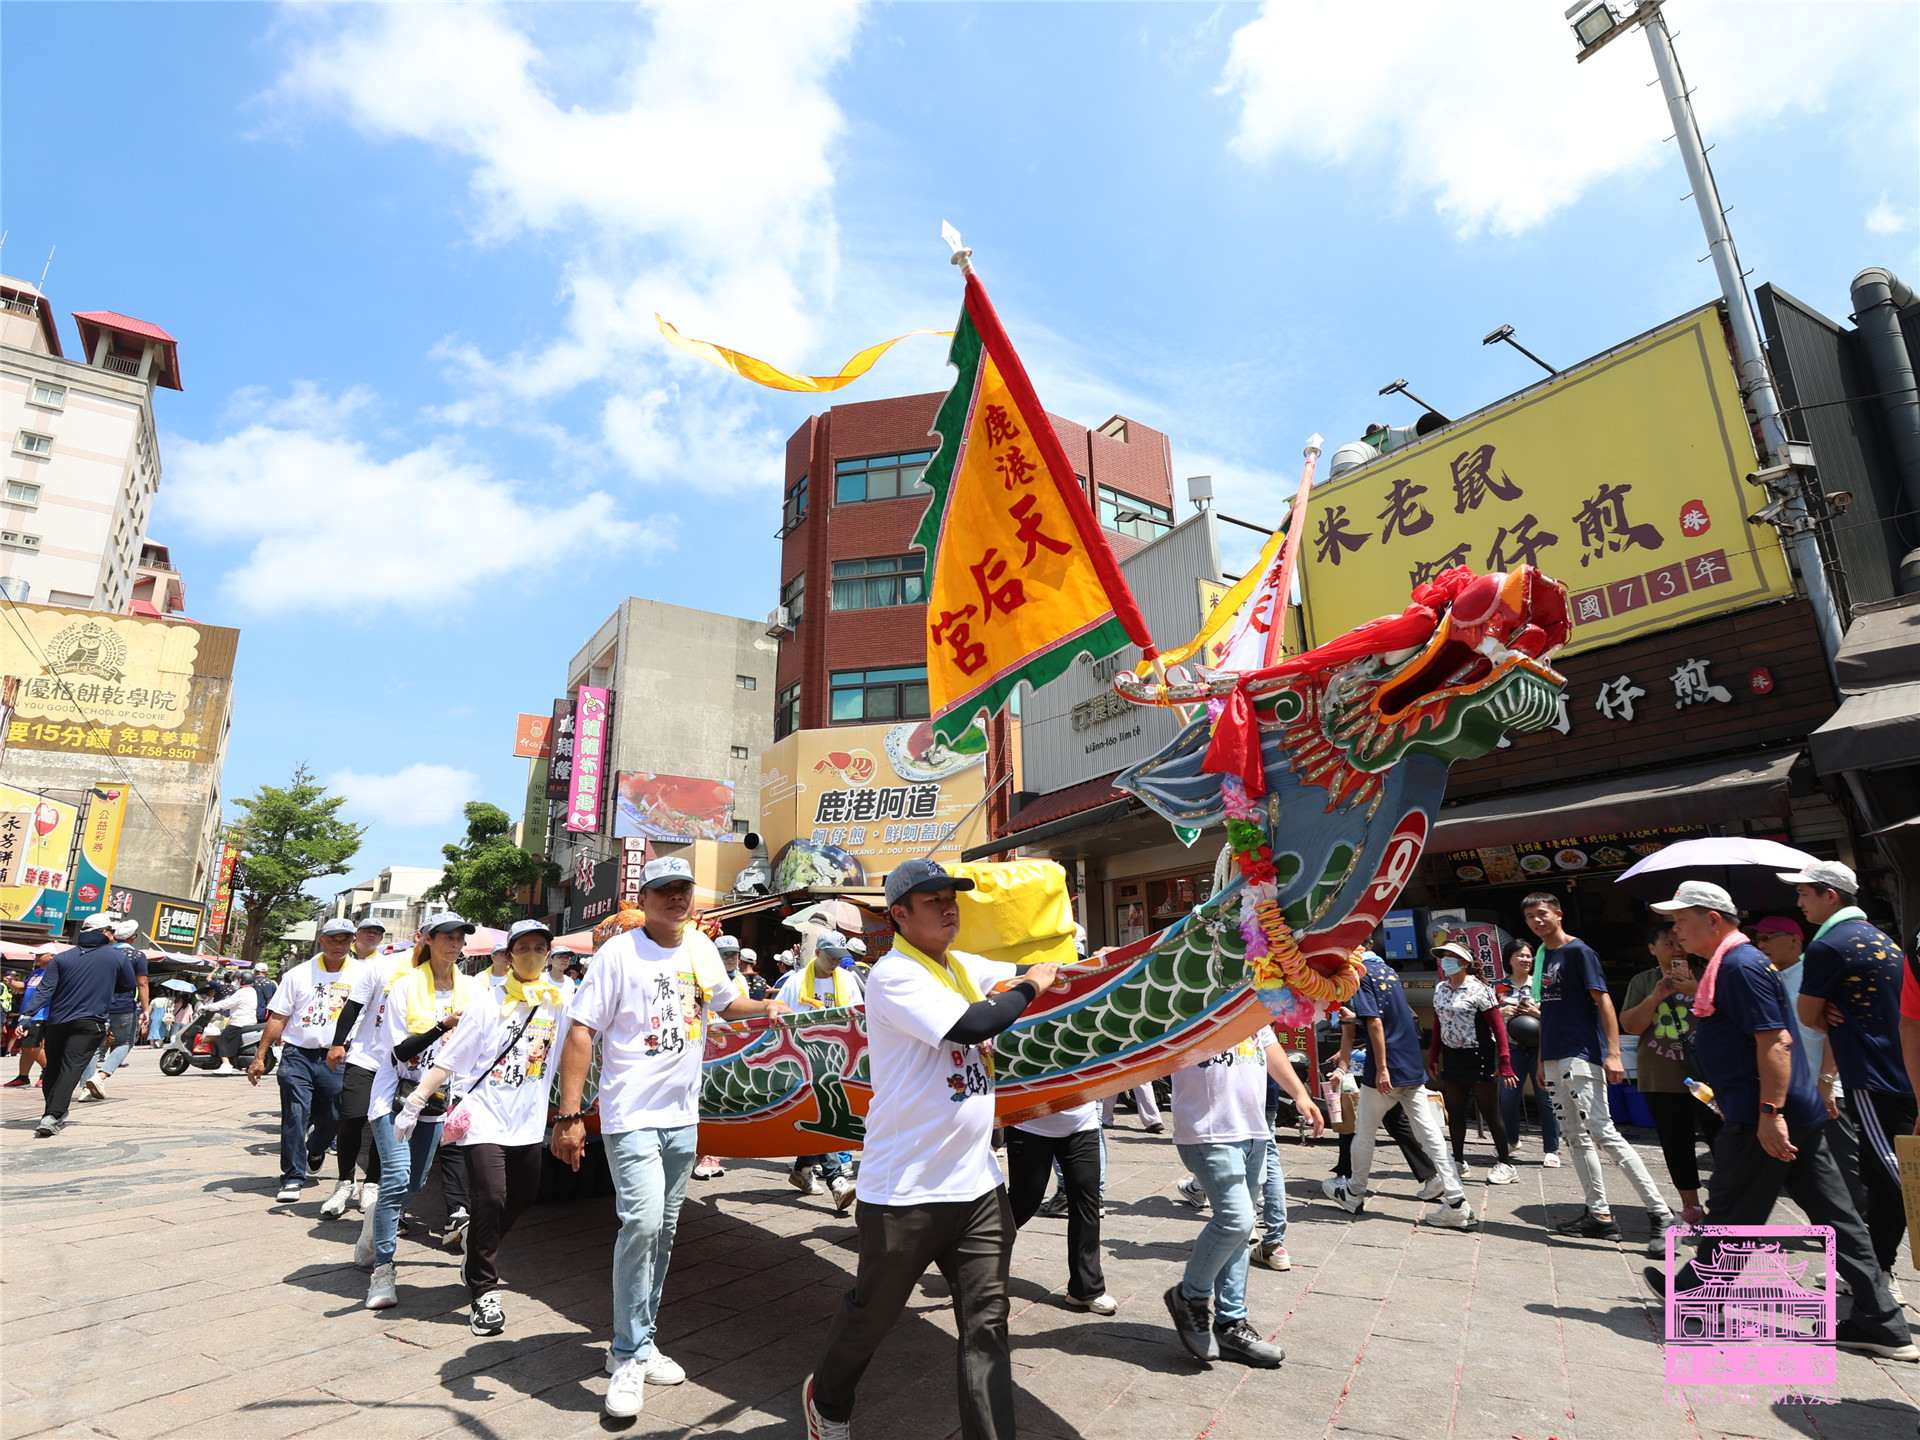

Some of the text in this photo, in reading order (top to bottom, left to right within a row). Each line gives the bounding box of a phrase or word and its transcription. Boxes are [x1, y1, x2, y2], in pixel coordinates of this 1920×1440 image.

[1313, 445, 1522, 565] 米老鼠
[1683, 509, 1708, 532] 珠
[931, 404, 1072, 676] 鹿港天后宮
[45, 622, 77, 657] TAIWAN
[115, 644, 128, 666] GOOD
[25, 677, 178, 711] 優格餅乾學院
[25, 702, 44, 710] YOU
[47, 703, 75, 713] GOOD
[79, 706, 115, 717] SCHOOL
[118, 710, 131, 718] OF
[132, 711, 165, 721] COOKIE
[117, 744, 197, 760] 04-758-9501
[119, 727, 200, 747] 免費參觀
[814, 784, 940, 823] 鹿港阿道
[92, 809, 110, 853] 公益彩券
[906, 845, 931, 853] OYSTER
